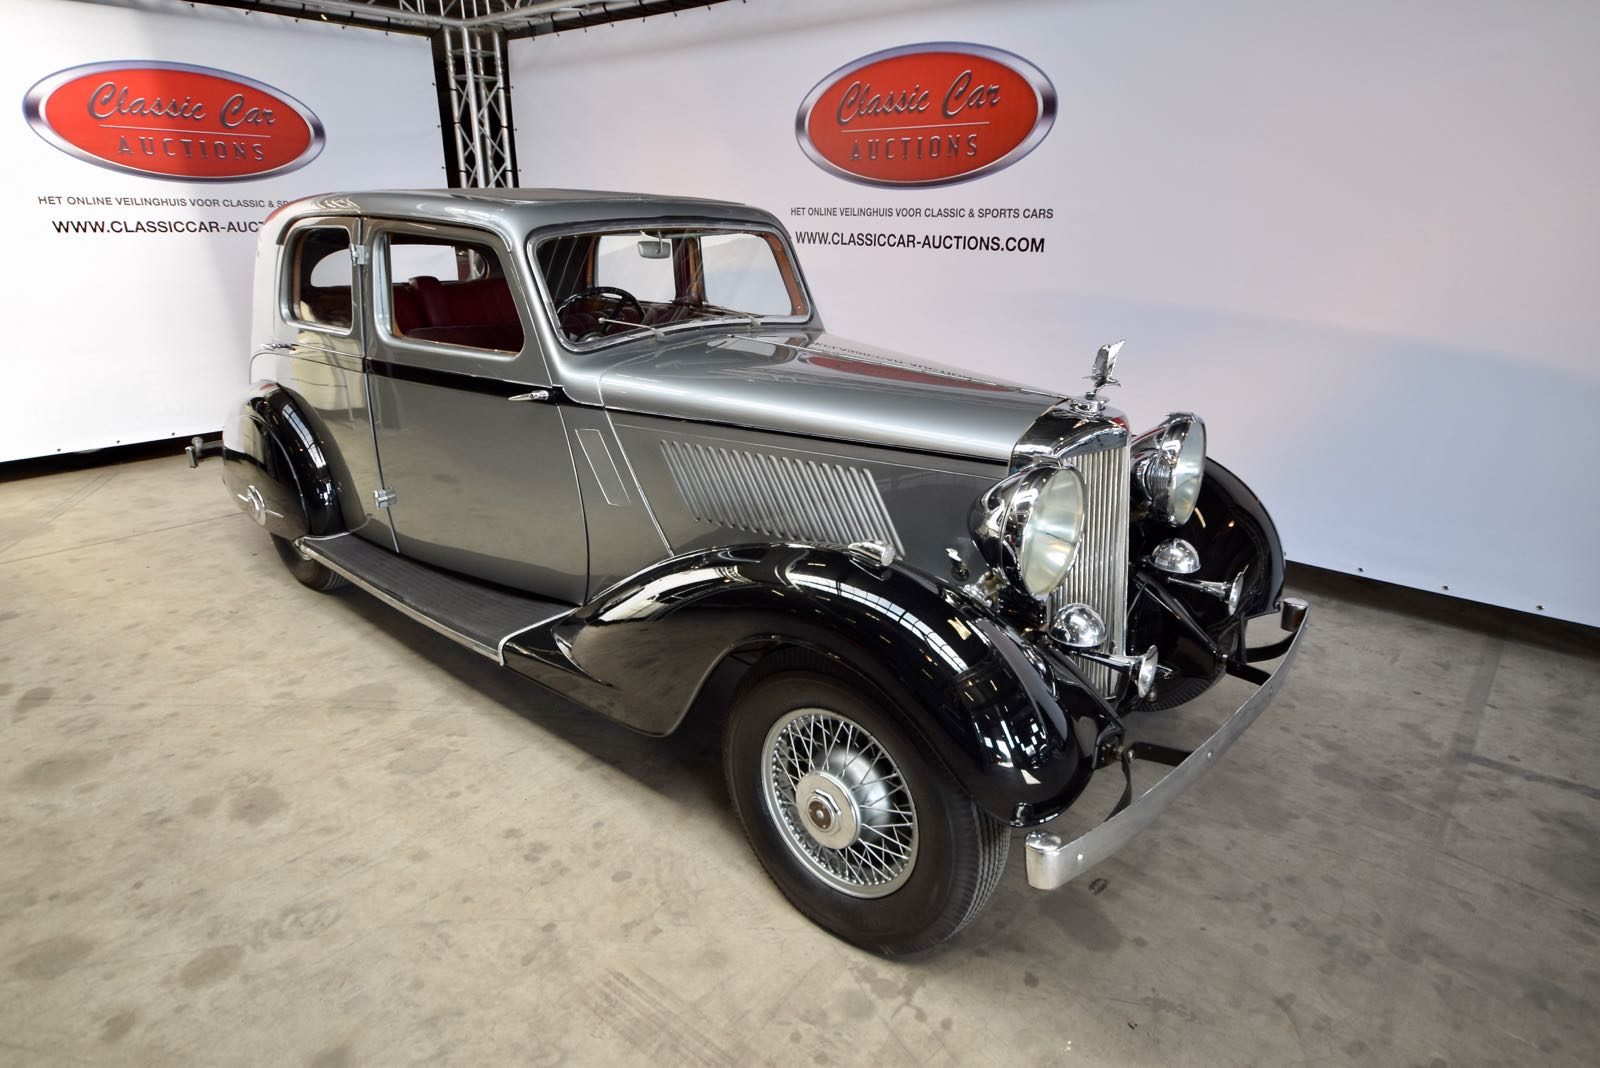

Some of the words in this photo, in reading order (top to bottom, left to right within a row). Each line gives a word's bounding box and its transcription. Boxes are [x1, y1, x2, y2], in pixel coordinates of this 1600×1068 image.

[88, 81, 206, 120] Classic
[220, 93, 277, 129] Car
[837, 81, 930, 126] Classic
[942, 69, 1001, 120] Car
[117, 135, 265, 161] AUCTIONS
[849, 133, 978, 161] AUCTIONS
[38, 196, 63, 205] HET
[66, 196, 113, 206] ONLINE
[115, 197, 187, 207] VEILINGHUIS
[189, 198, 220, 207] VOOR
[222, 199, 266, 208] CLASSIC
[267, 200, 275, 208] &
[790, 207, 806, 216] HET
[807, 207, 838, 217] ONLINE
[839, 207, 894, 217] VEILINGHUIS
[895, 207, 922, 218] VOOR
[924, 208, 966, 218] CLASSIC
[968, 208, 976, 218] &
[977, 208, 1020, 219] SPORTS
[1022, 208, 1054, 219] CARS
[795, 231, 1046, 253] WWW.CLASSICCAR-AUCTIONS.COM
